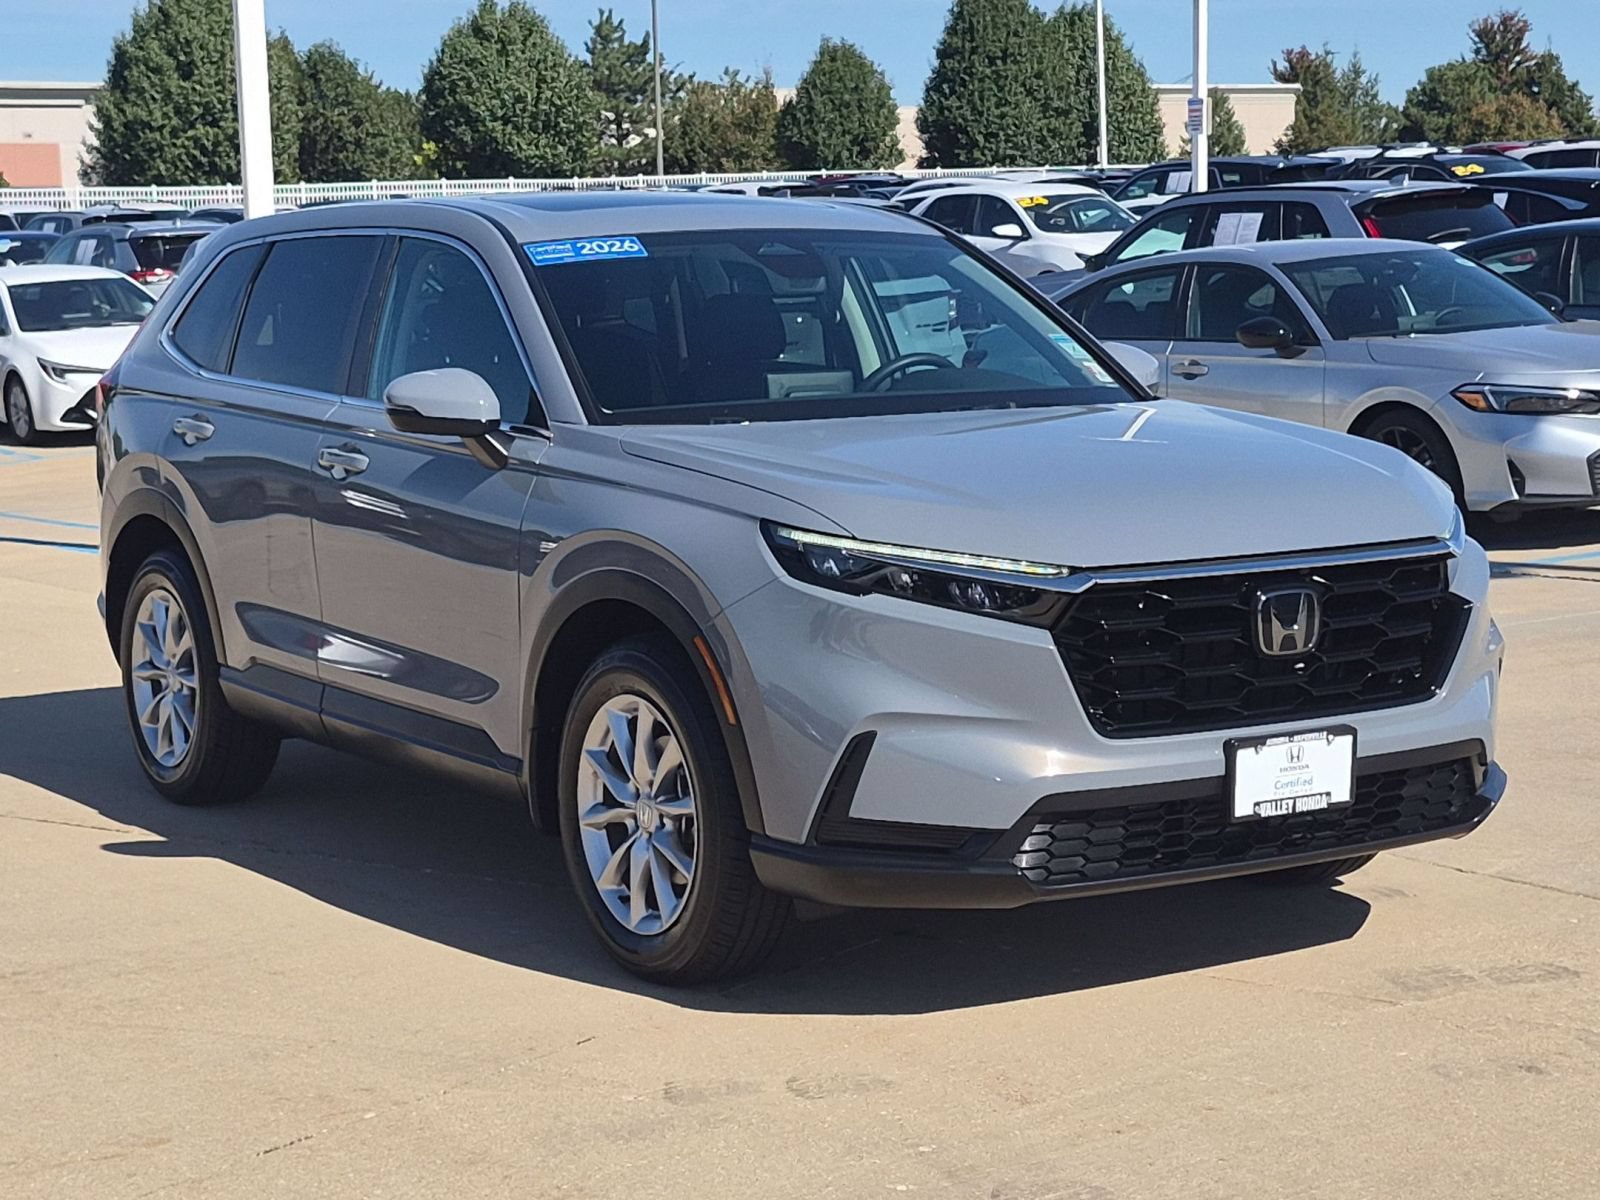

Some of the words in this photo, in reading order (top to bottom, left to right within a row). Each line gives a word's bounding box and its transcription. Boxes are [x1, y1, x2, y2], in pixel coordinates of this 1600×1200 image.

[576, 240, 640, 254] 2026
[1274, 776, 1313, 790] Certified
[1260, 799, 1295, 818] VALLEY
[1295, 793, 1328, 813] HONDA
